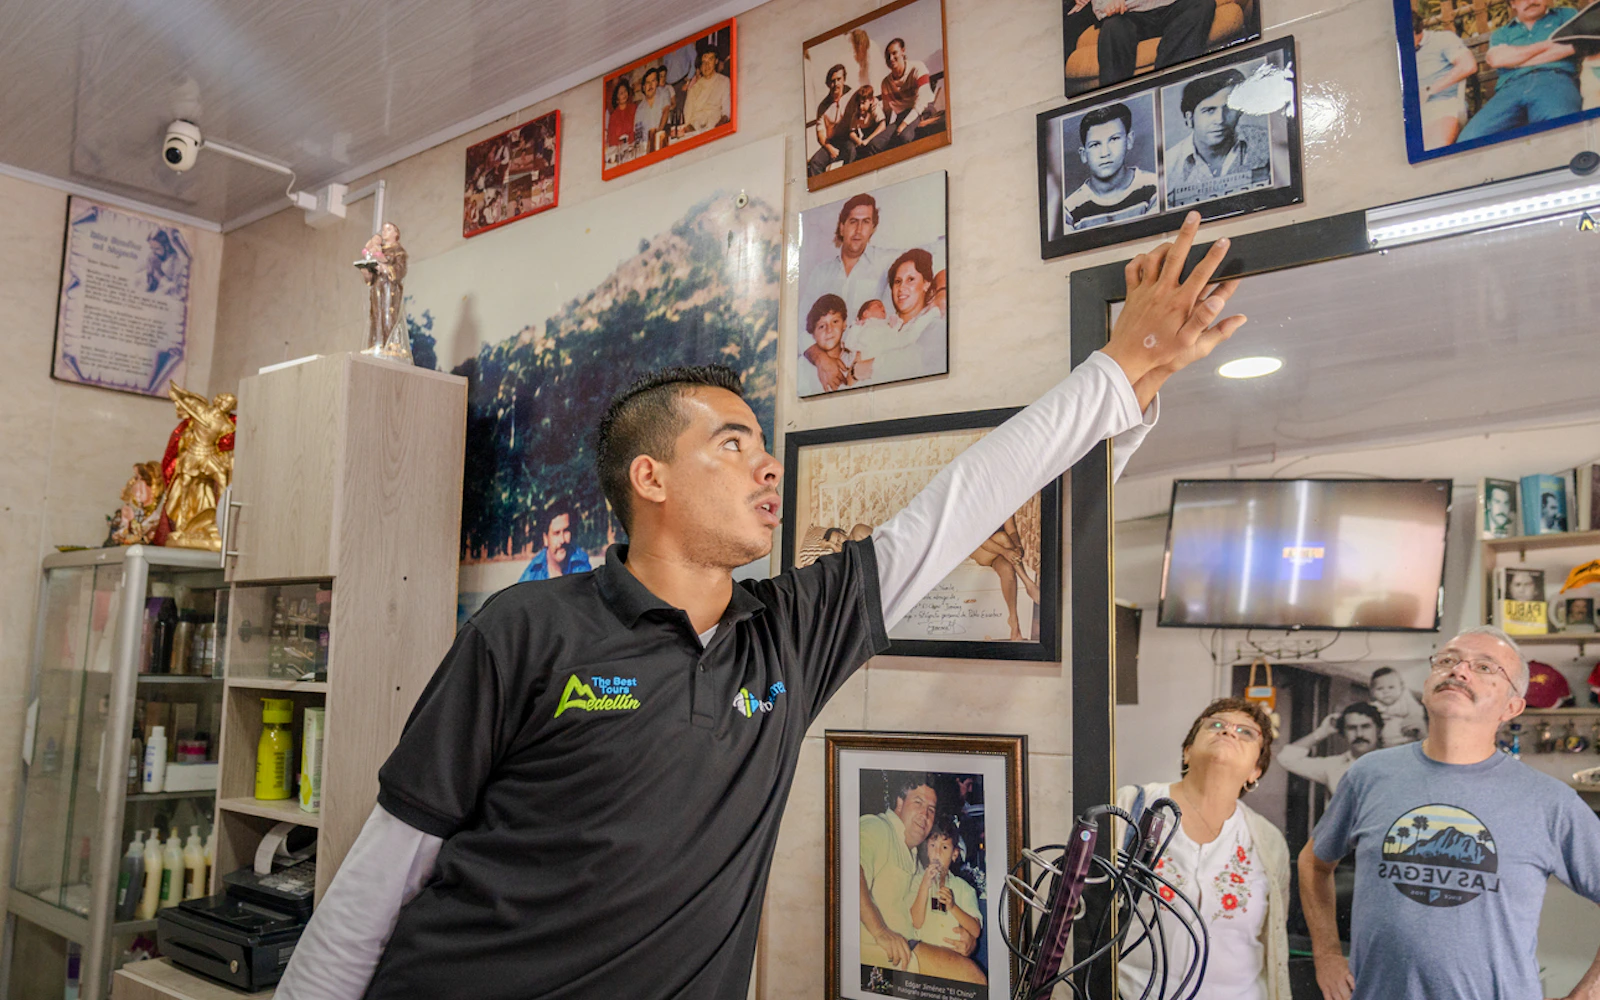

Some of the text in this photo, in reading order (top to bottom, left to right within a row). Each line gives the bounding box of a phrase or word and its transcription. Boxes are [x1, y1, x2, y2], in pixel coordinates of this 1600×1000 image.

[591, 676, 637, 687] The Best
[601, 685, 630, 695] Tours
[904, 980, 921, 990] Edgar
